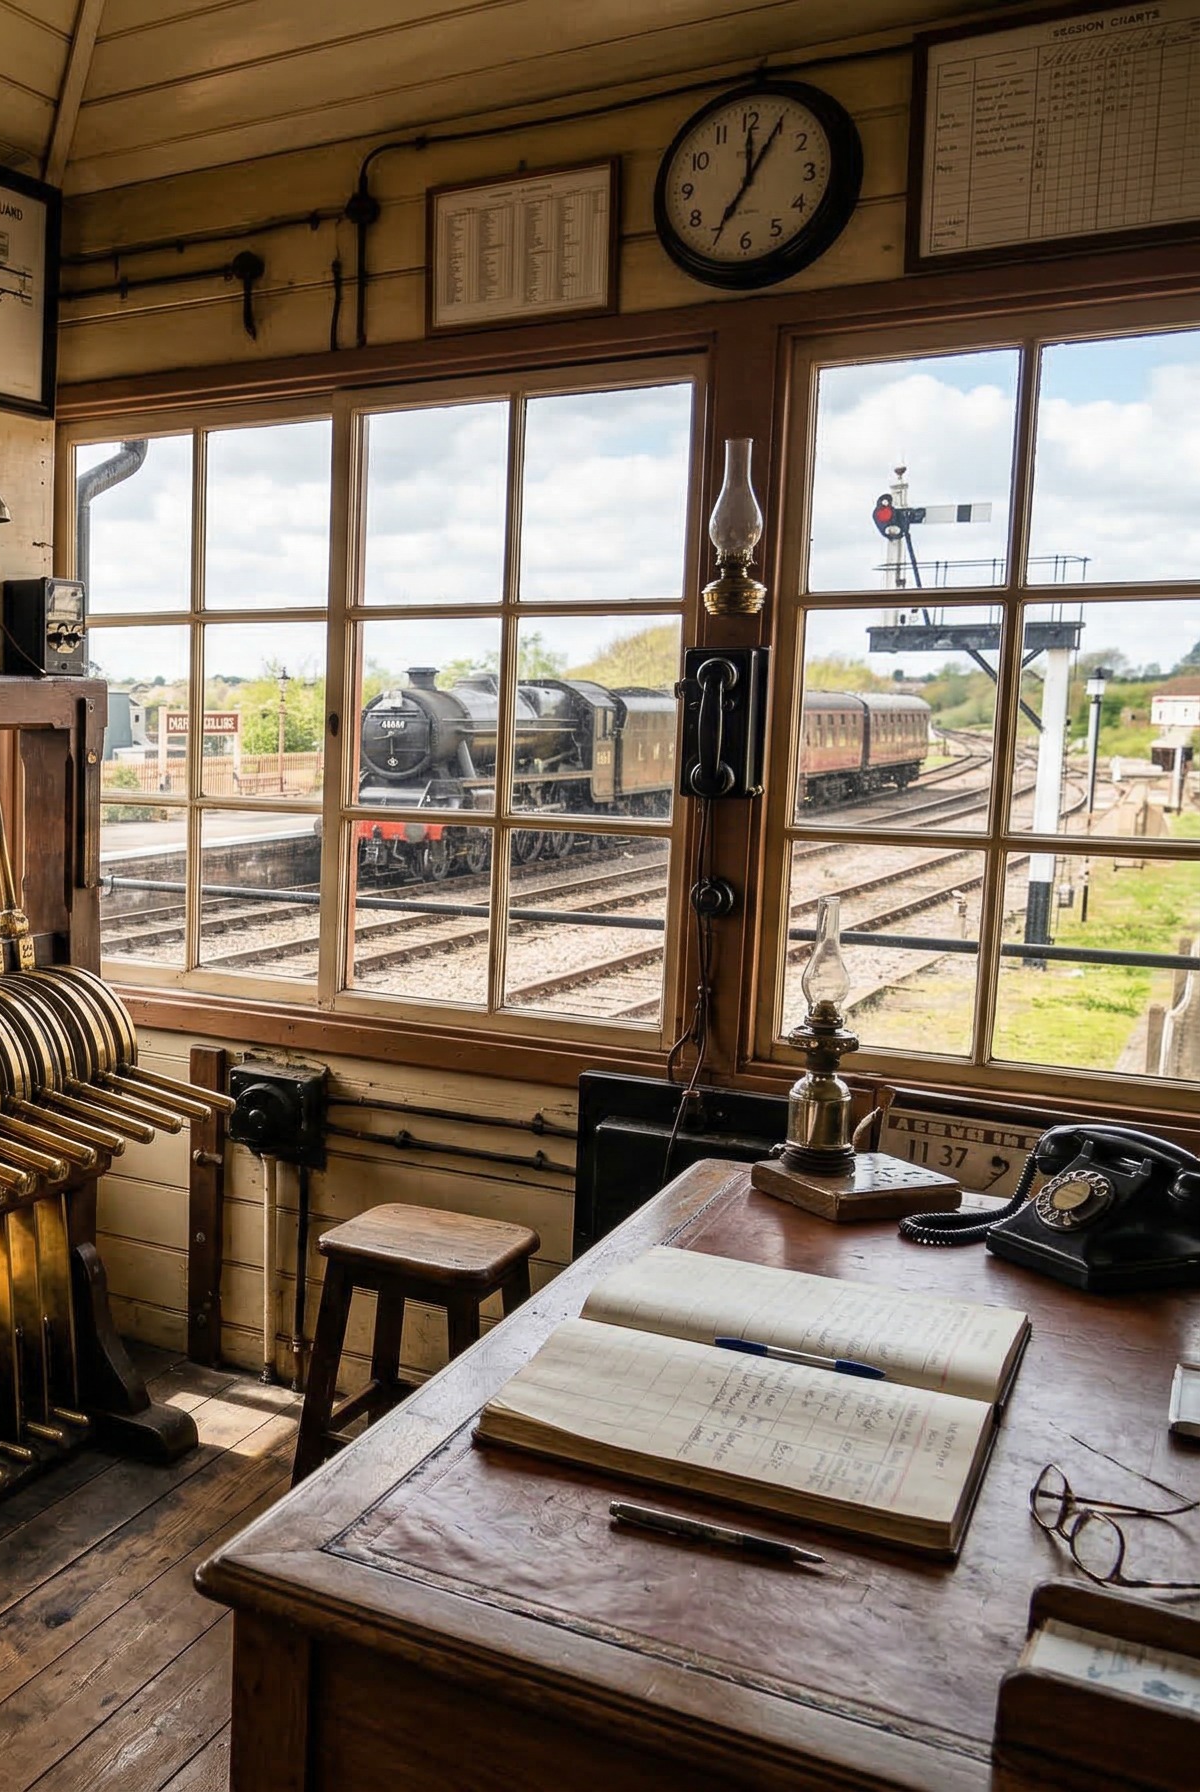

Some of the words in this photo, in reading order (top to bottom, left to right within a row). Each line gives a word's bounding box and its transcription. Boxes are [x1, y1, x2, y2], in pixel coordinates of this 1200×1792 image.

[743, 112, 760, 132] 12
[716, 125, 727, 145] 11
[795, 133, 808, 152] 2
[692, 152, 710, 171] 10
[803, 162, 816, 181] 3
[681, 183, 694, 200] 9
[791, 193, 805, 213] 4
[690, 209, 702, 227] 8
[770, 218, 782, 237] 5
[711, 225, 723, 246] 7
[740, 231, 752, 249] 6
[939, 1145, 969, 1169] 37
